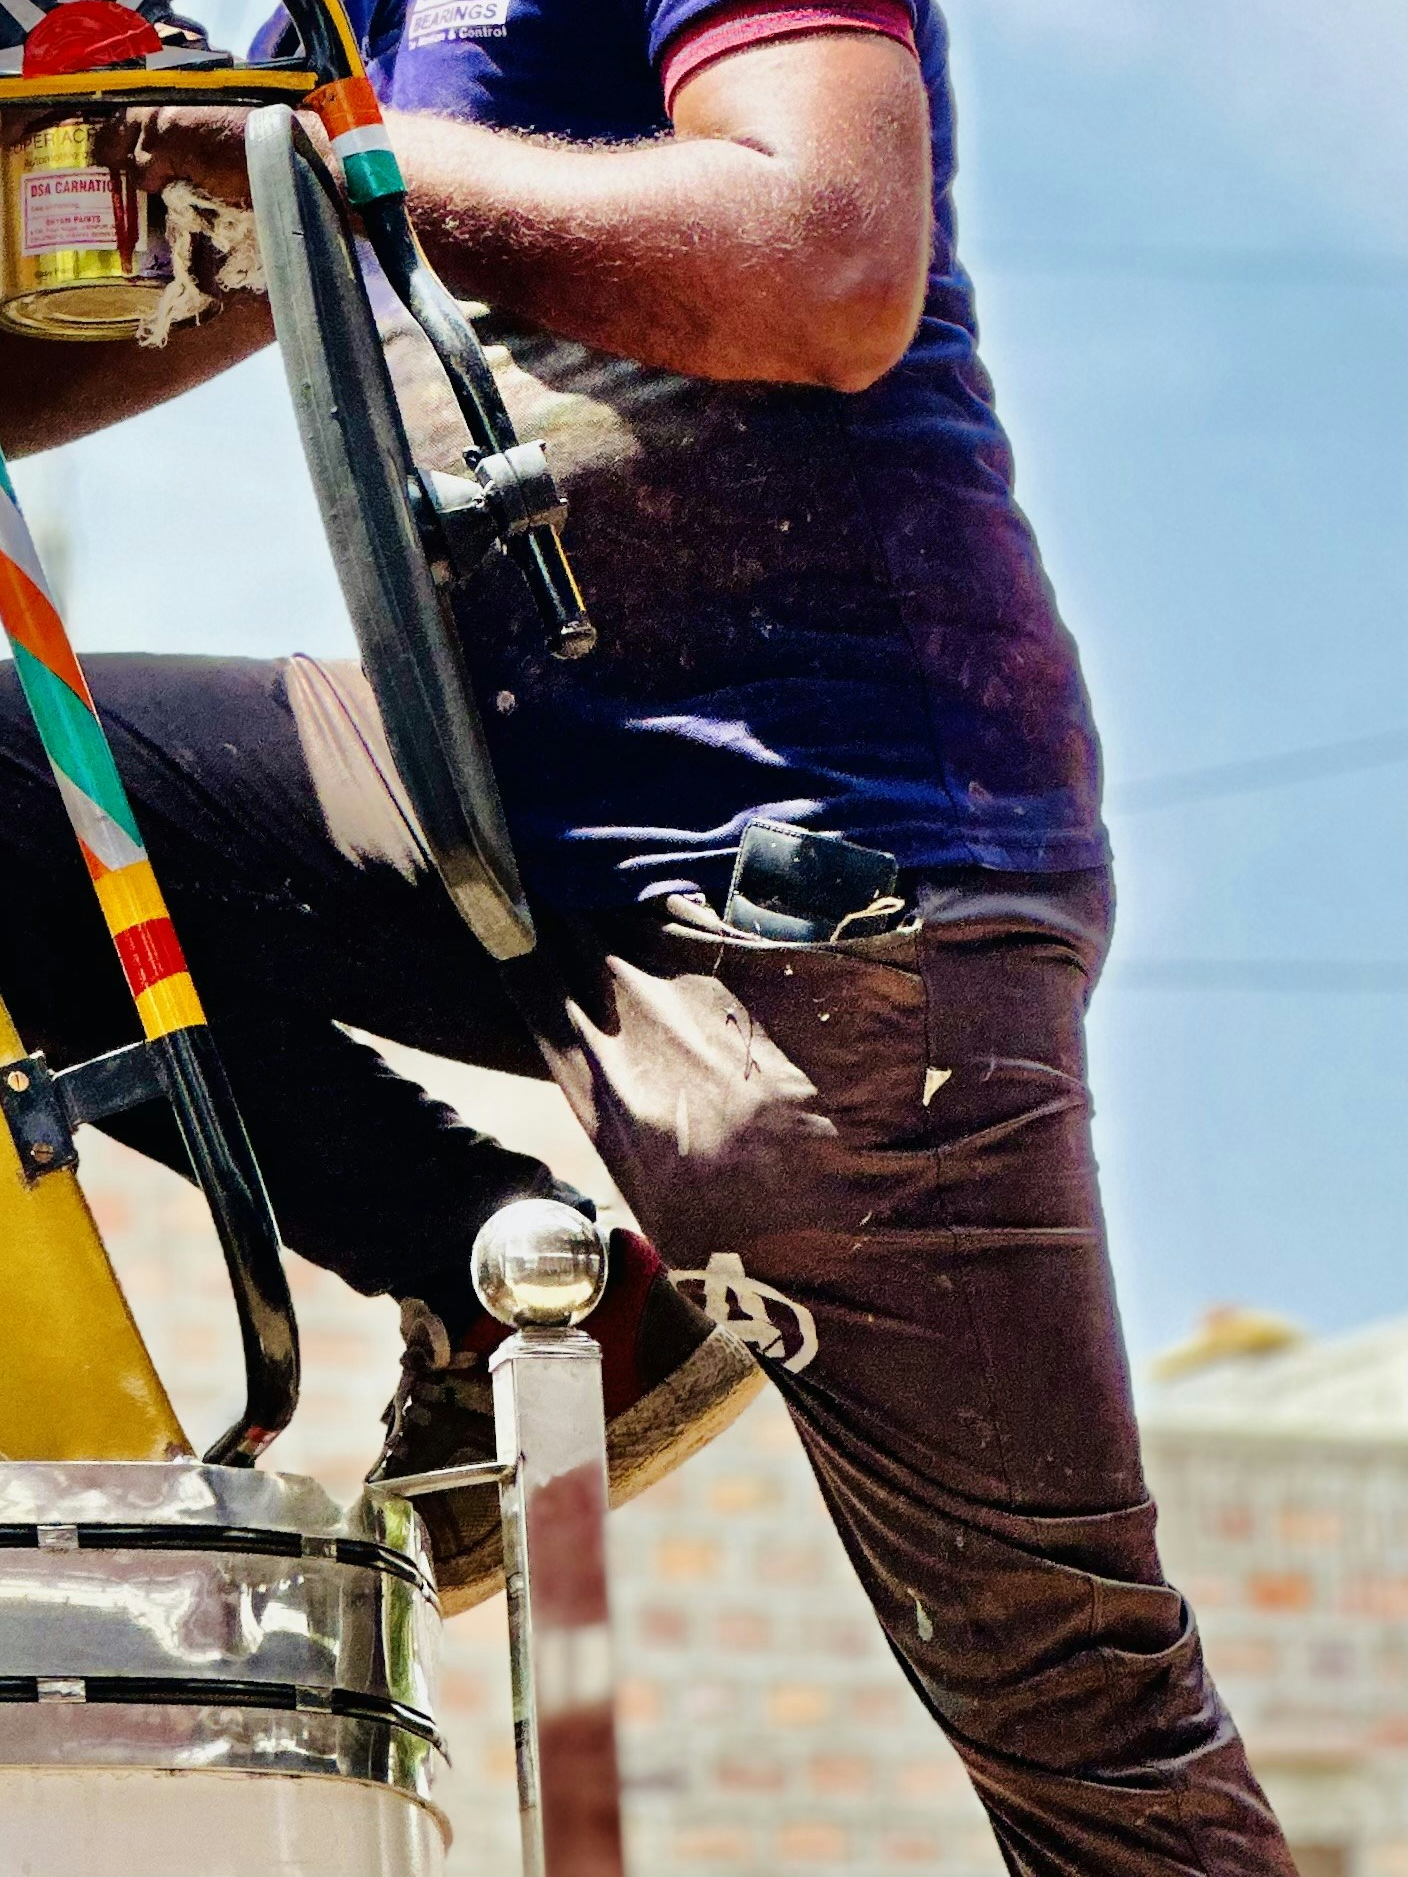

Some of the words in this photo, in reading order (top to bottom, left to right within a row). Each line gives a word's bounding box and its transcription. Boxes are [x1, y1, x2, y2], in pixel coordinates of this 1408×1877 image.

[413, 3, 498, 33] BEARINGS
[458, 25, 507, 39] Control
[30, 183, 51, 198] DSA
[55, 179, 115, 195] CARNATIO
